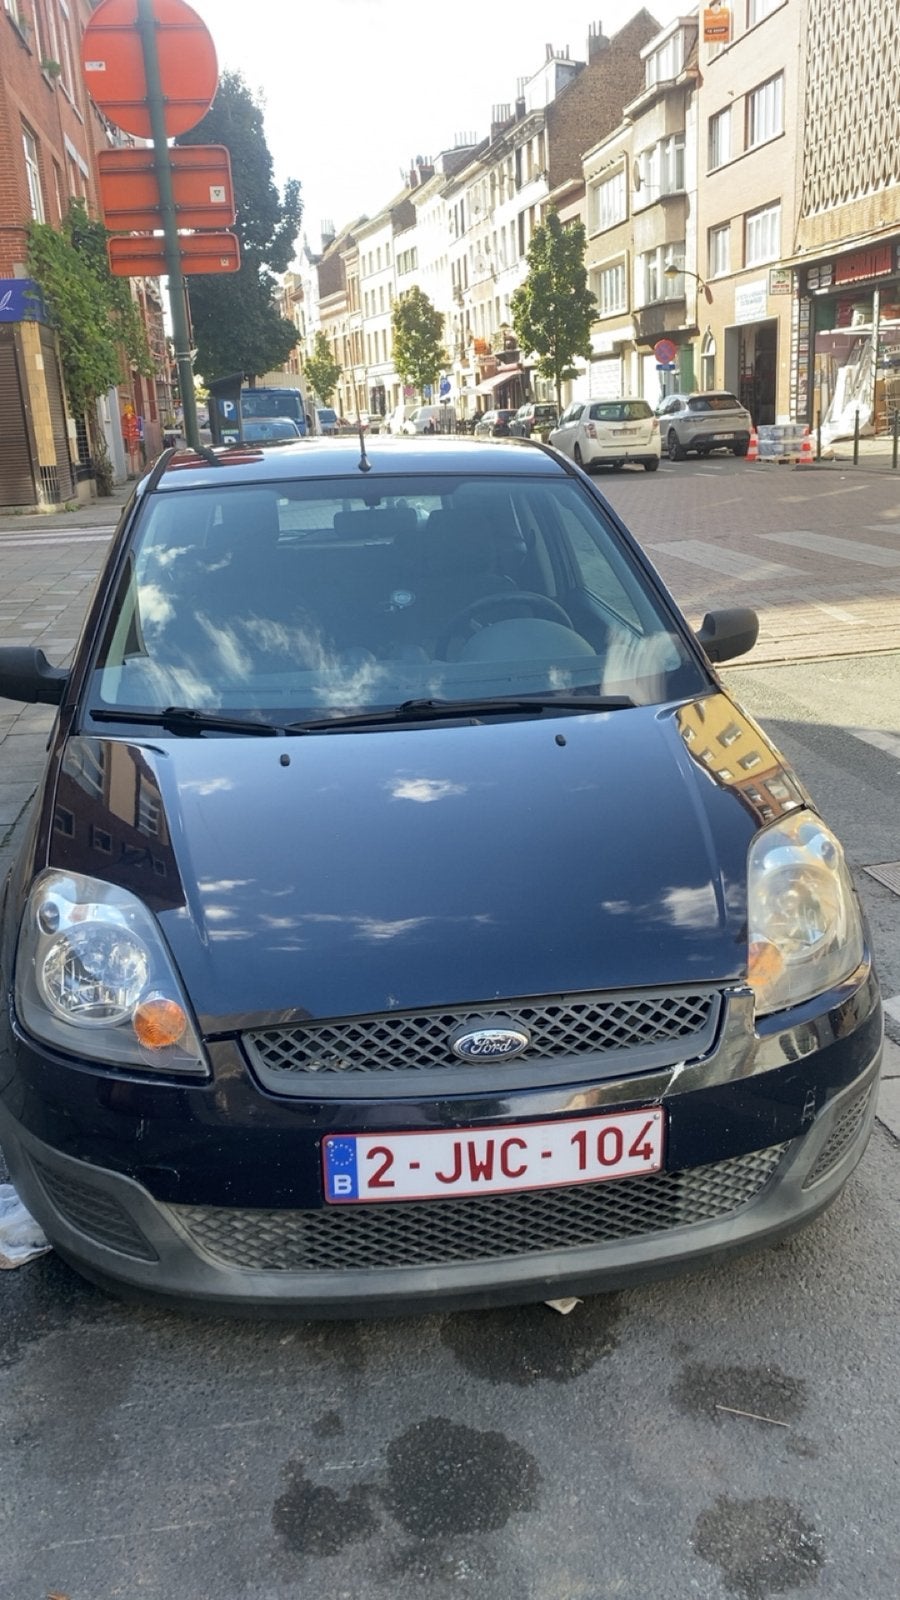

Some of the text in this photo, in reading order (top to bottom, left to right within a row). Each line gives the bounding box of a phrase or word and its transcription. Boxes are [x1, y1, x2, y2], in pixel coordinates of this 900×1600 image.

[223, 401, 234, 418] P
[470, 1038, 512, 1055] Ford
[333, 1174, 352, 1195] B
